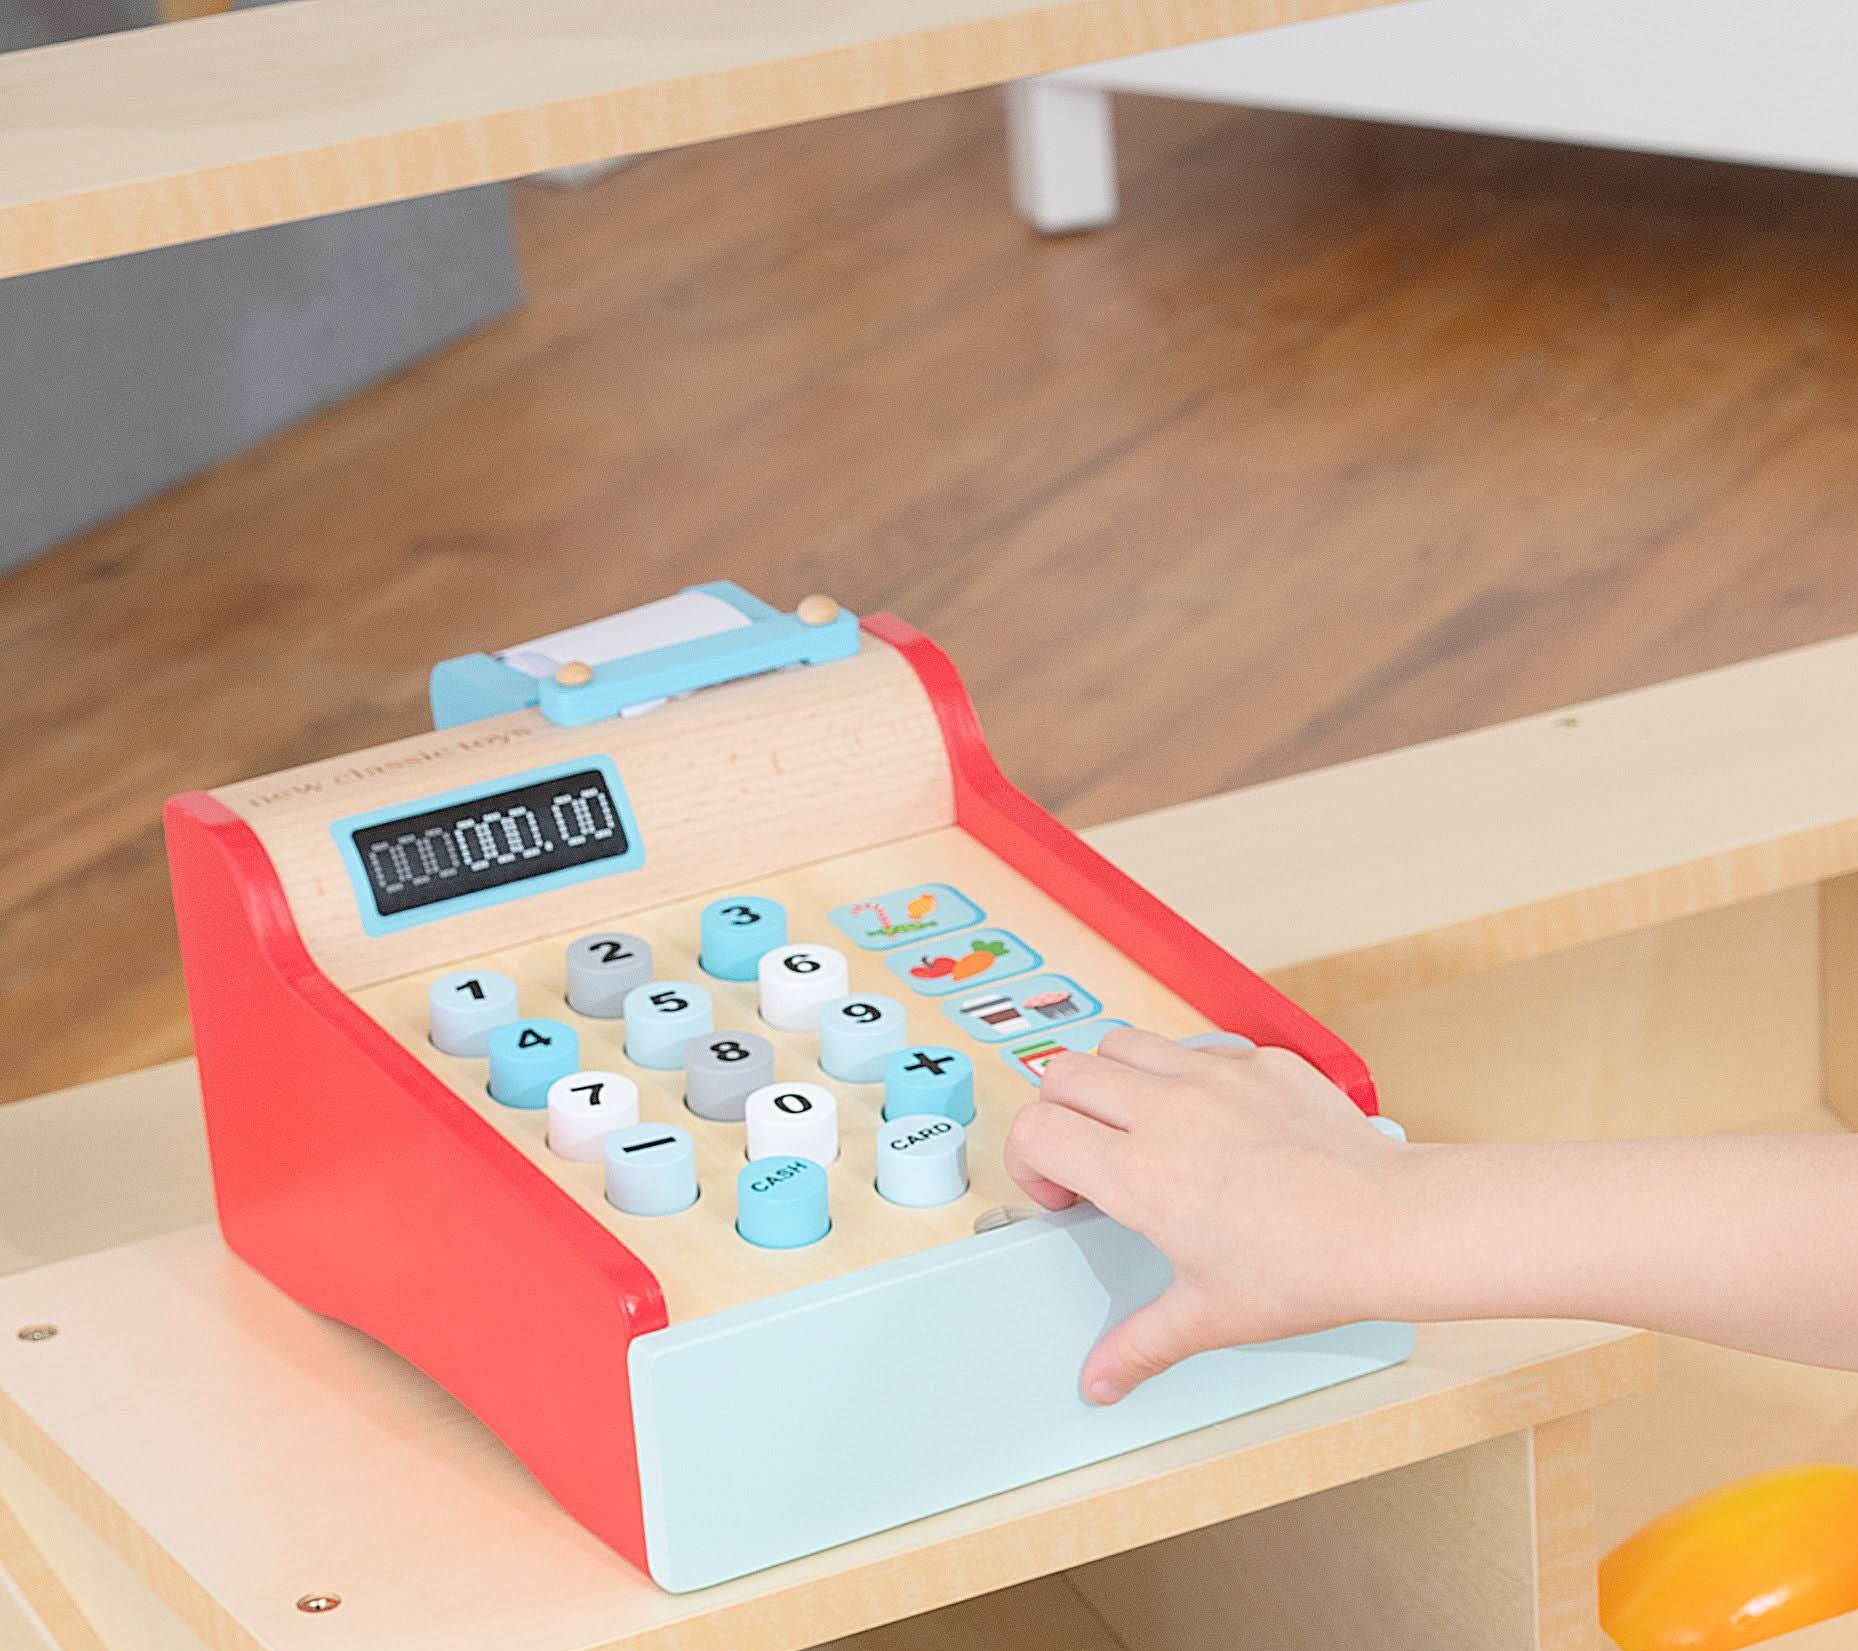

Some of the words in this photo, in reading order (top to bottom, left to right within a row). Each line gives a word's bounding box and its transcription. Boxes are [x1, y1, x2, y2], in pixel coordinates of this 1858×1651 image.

[721, 905, 762, 926] 3
[588, 940, 634, 964] 2
[783, 954, 821, 974] 6
[455, 979, 486, 1001] 1
[649, 991, 689, 1013] 5
[842, 1003, 882, 1024] 9
[518, 1028, 552, 1050] 4
[709, 1040, 751, 1063] 8
[570, 1082, 605, 1106] 7
[773, 1093, 813, 1114] 0
[890, 1121, 952, 1151] CARD
[750, 1160, 808, 1193] CASH
